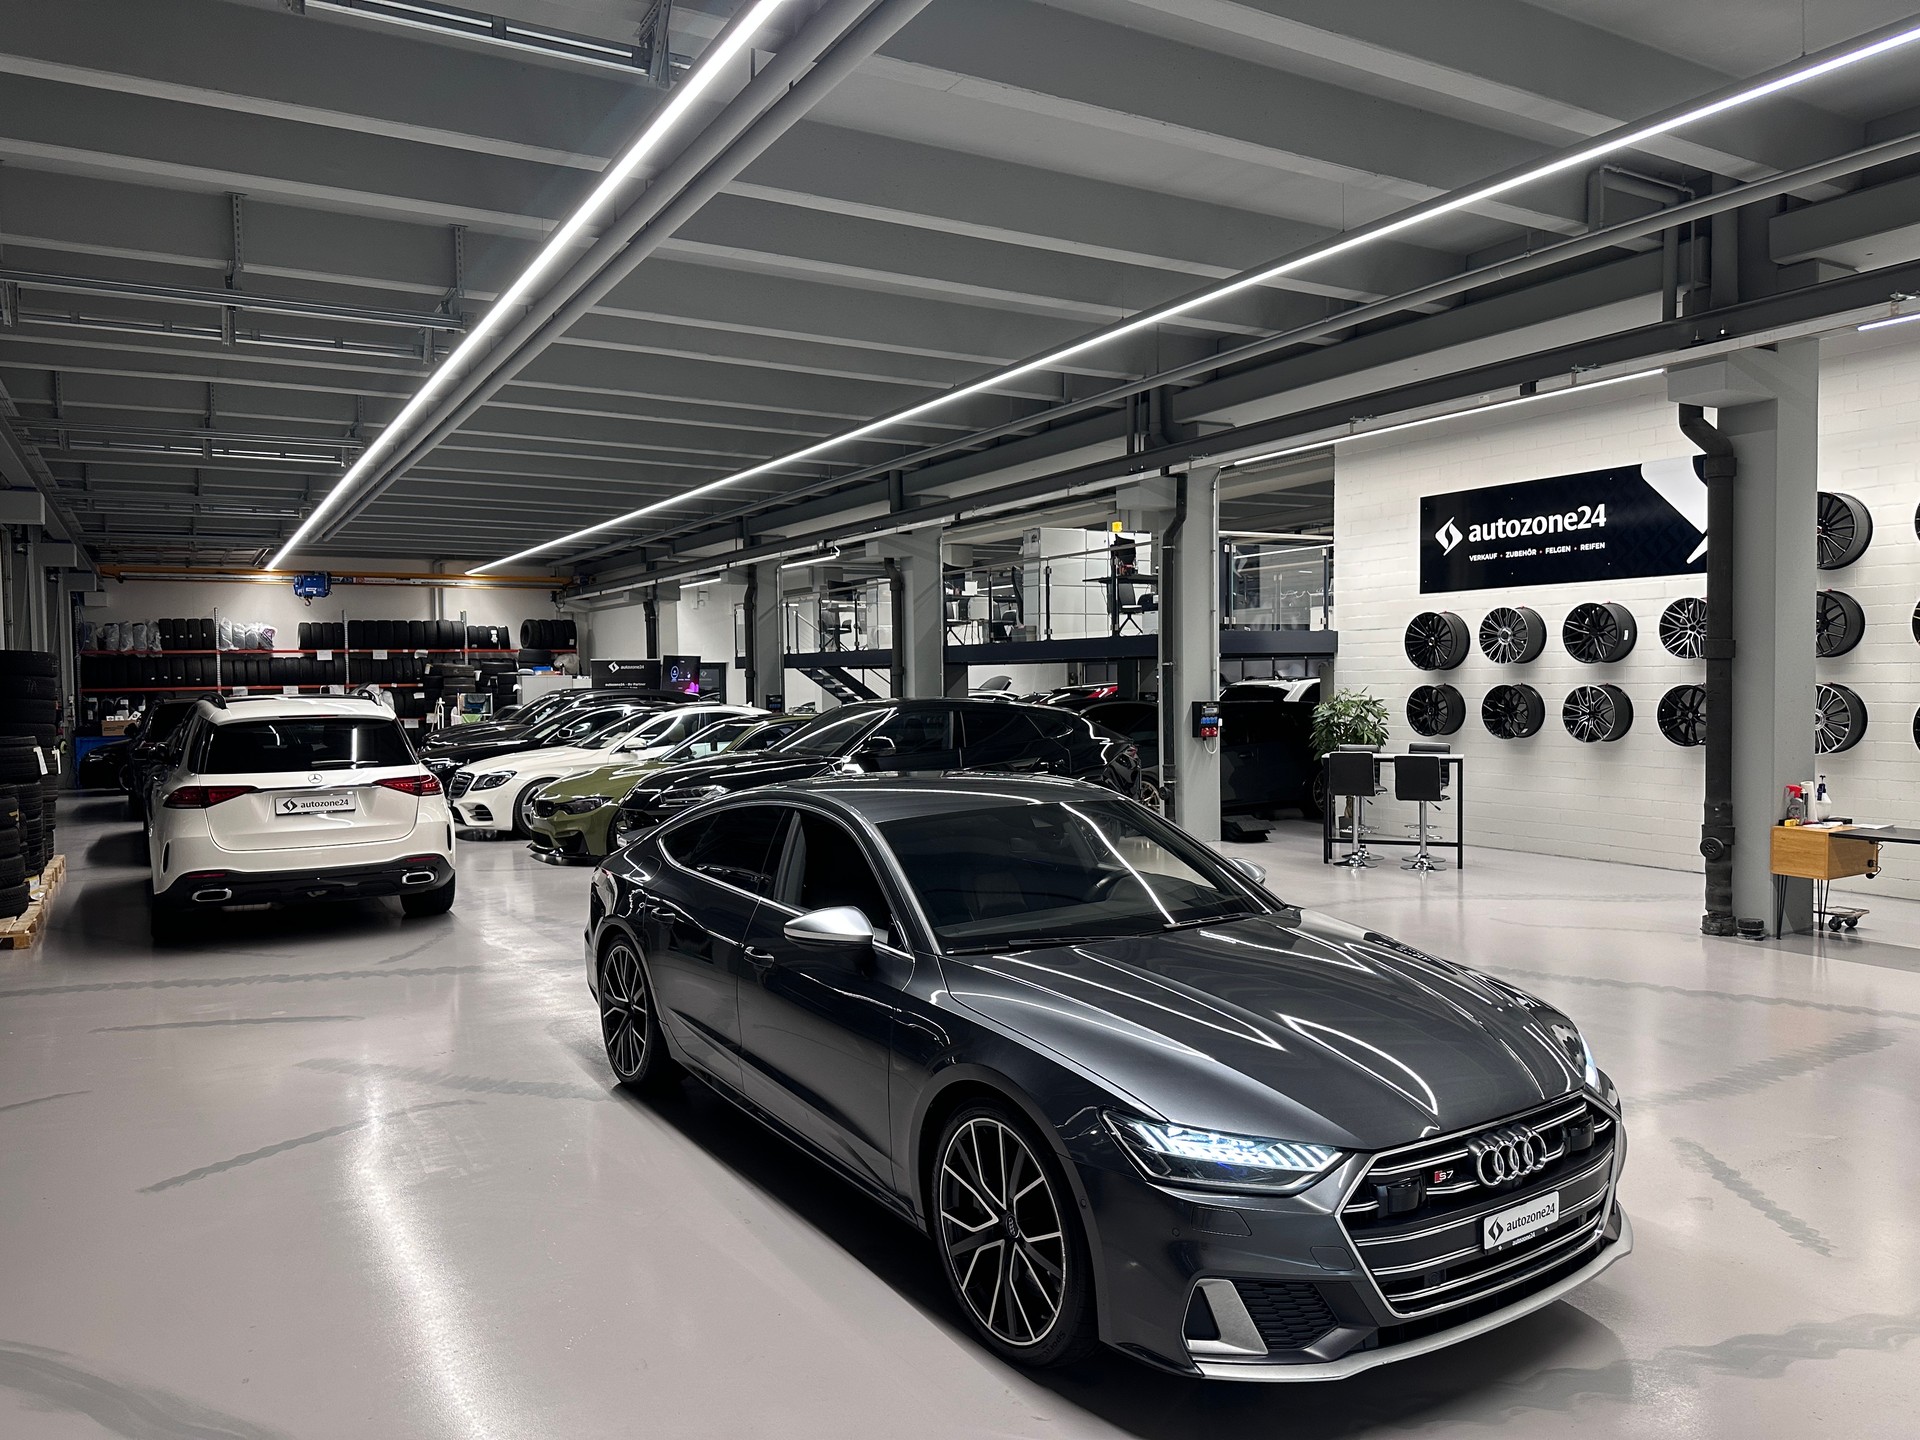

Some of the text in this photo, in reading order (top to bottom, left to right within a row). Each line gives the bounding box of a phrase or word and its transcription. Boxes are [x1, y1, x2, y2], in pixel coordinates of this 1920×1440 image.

[1468, 503, 1607, 543] autozone24
[1469, 541, 1606, 562] VERKAUF ZUBEHÖR FELGEN REIFEN
[300, 798, 349, 809] autozone24
[1437, 1169, 1454, 1182] S7
[1506, 1203, 1555, 1232] autozone24
